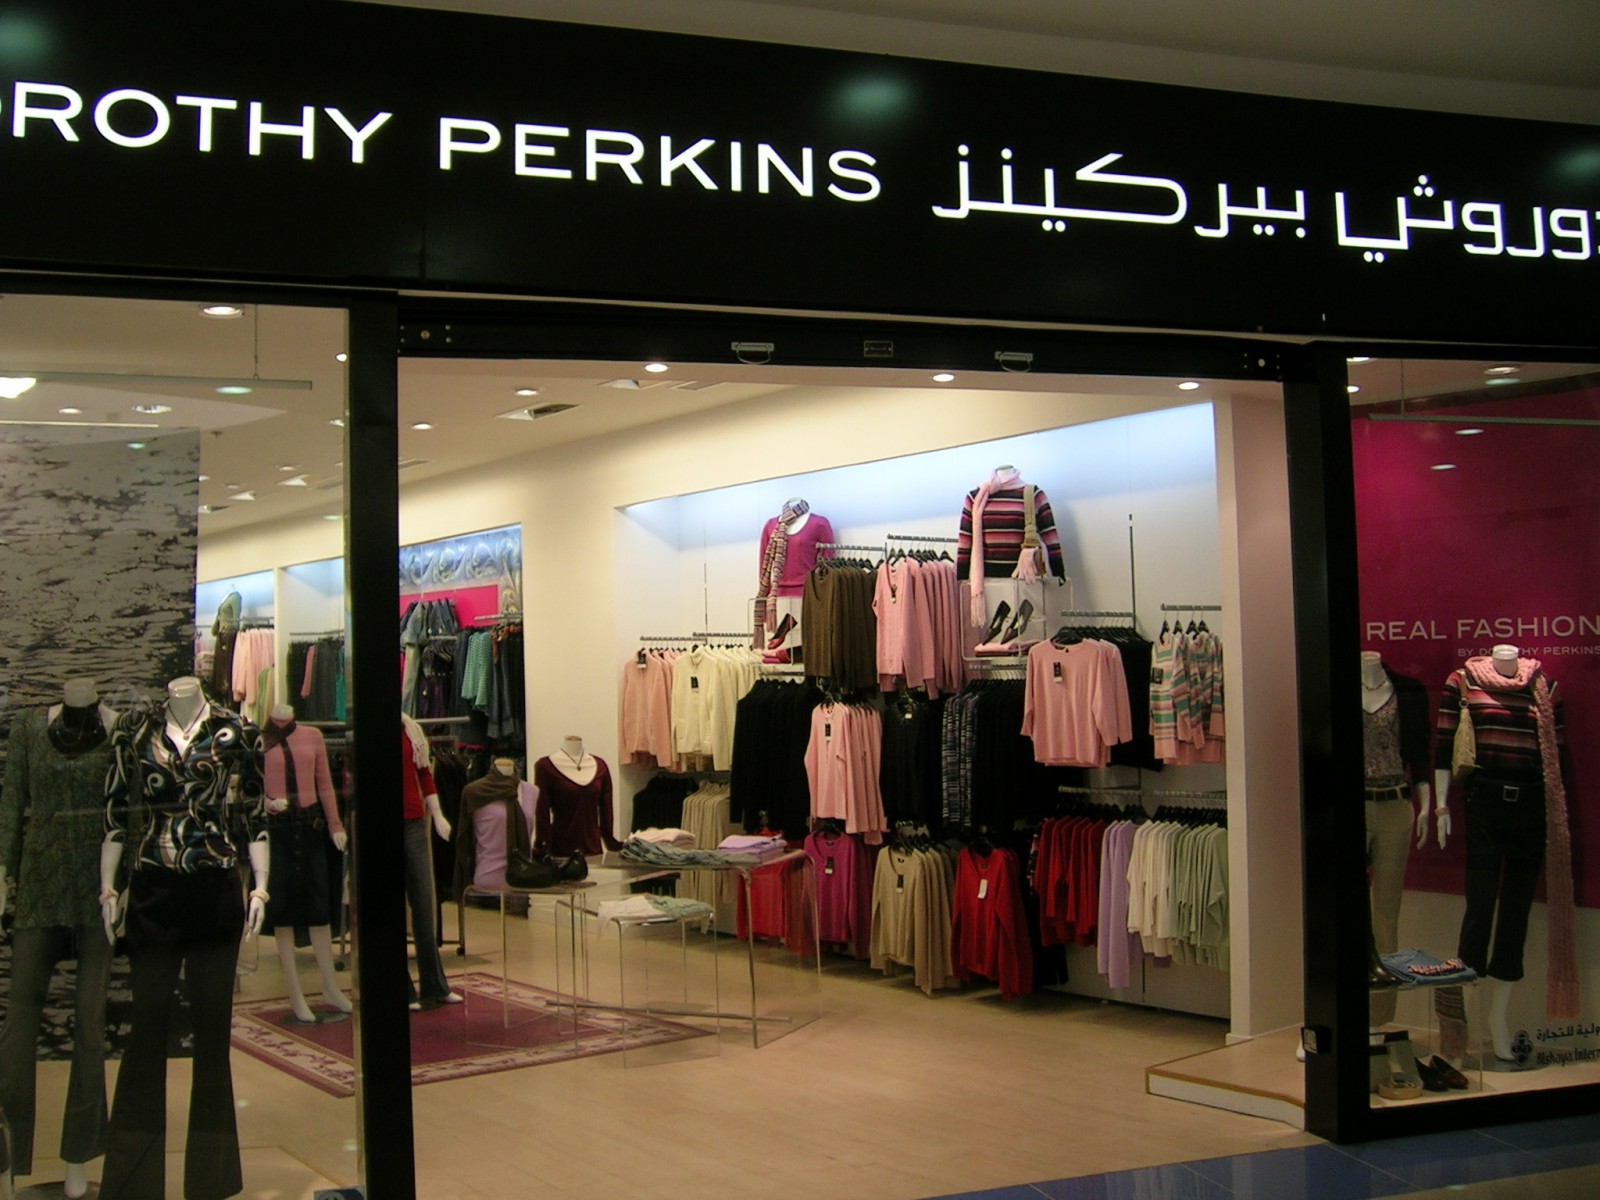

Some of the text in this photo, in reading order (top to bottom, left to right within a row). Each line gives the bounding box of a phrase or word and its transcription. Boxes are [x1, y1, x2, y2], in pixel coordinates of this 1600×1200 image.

[0, 81, 882, 202] ROTHY PERKINS
[931, 144, 1600, 263] وروثي بيركينز
[1366, 615, 1600, 641] REAL FASHION
[1458, 648, 1475, 658] BY
[1543, 645, 1600, 656] PERKINS
